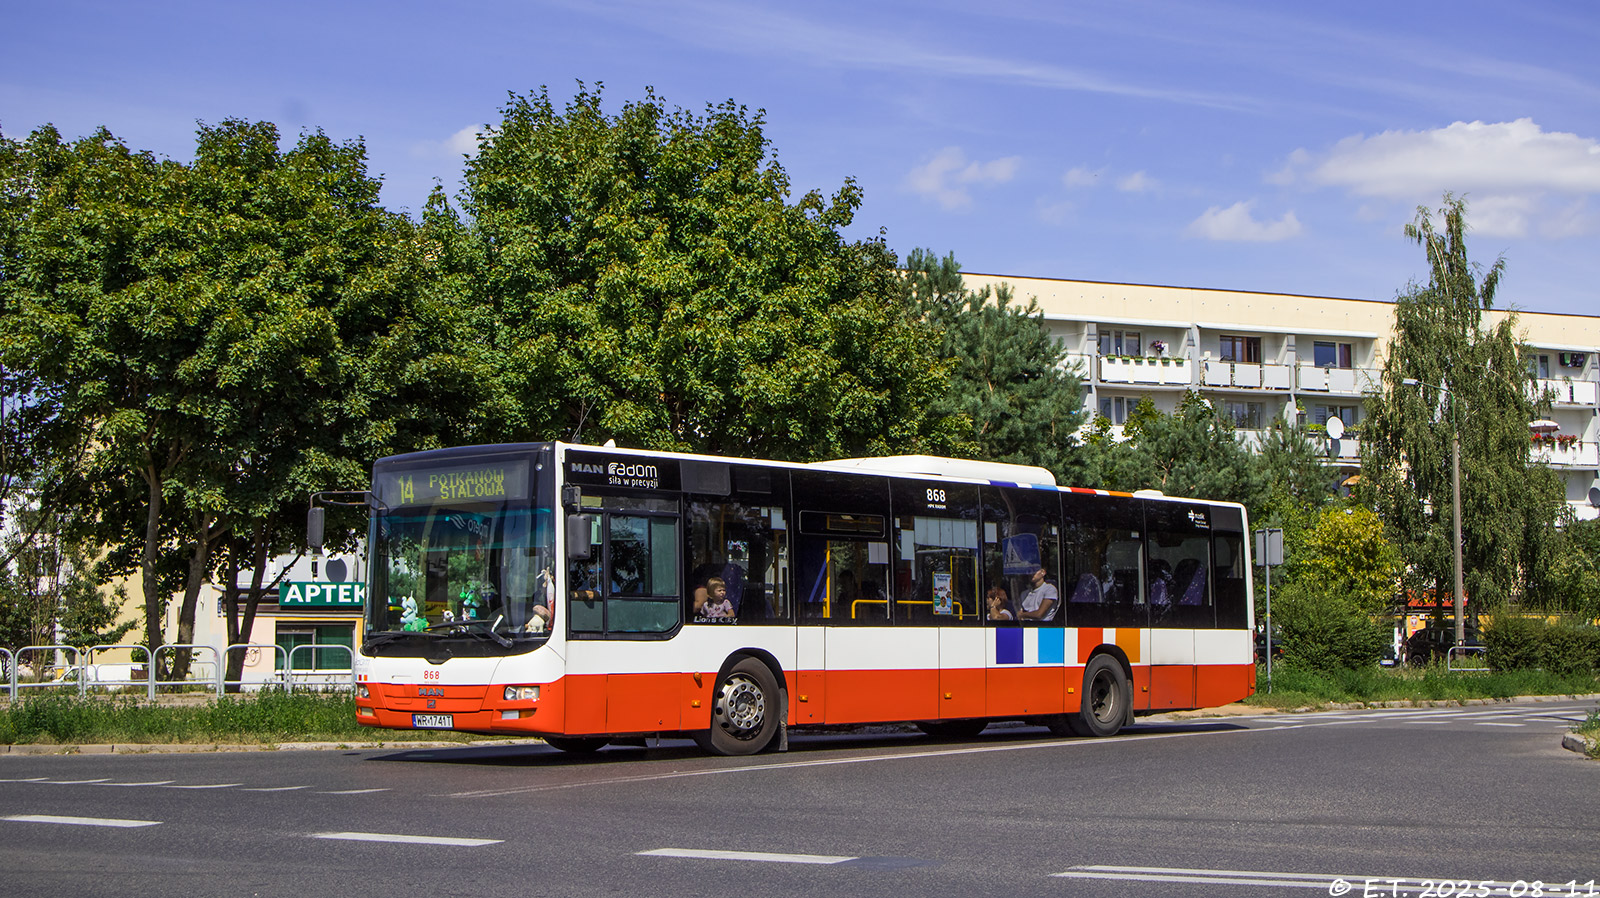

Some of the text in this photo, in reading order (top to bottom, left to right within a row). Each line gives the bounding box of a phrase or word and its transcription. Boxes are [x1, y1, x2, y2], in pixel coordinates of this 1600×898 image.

[571, 463, 604, 474] MAN
[399, 474, 414, 504] 14
[631, 478, 658, 489] precyzji
[440, 481, 505, 499] STALOWA
[926, 488, 946, 502] 868
[284, 584, 392, 603] APTEK
[423, 670, 440, 680] 868
[418, 687, 445, 697] MAN
